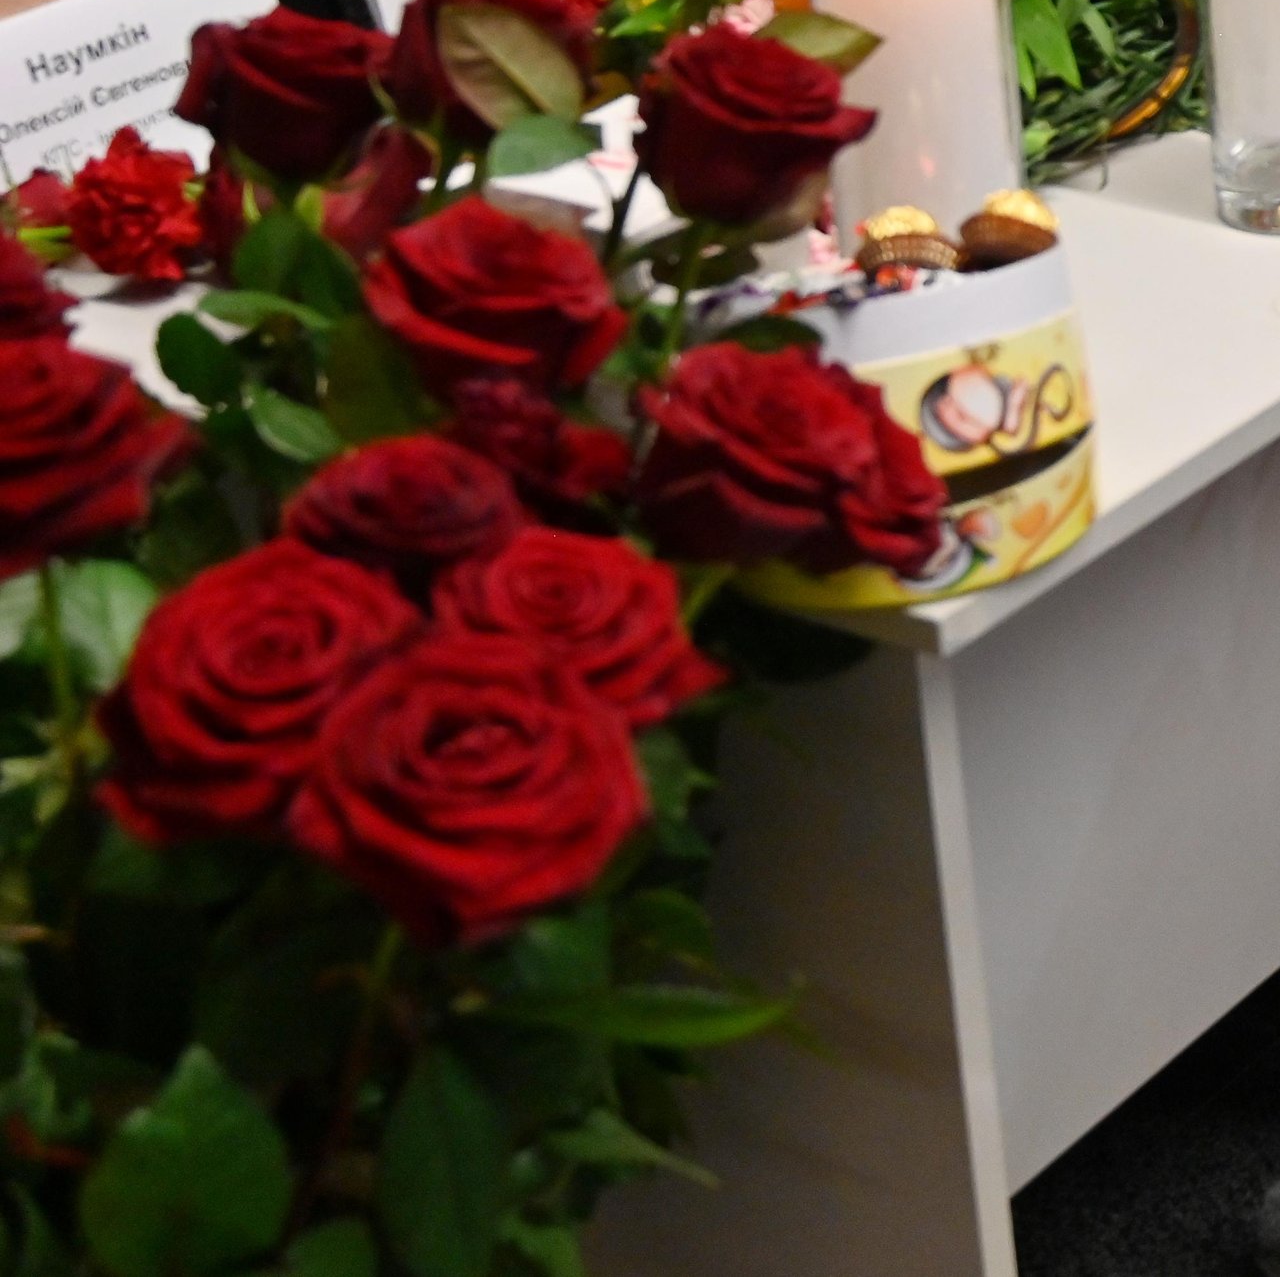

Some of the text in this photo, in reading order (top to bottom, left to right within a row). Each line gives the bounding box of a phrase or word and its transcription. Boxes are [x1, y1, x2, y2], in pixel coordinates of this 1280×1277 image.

[25, 23, 150, 83] Наумкін
[0, 94, 86, 144] Олексій
[90, 59, 191, 107] Євгенов
